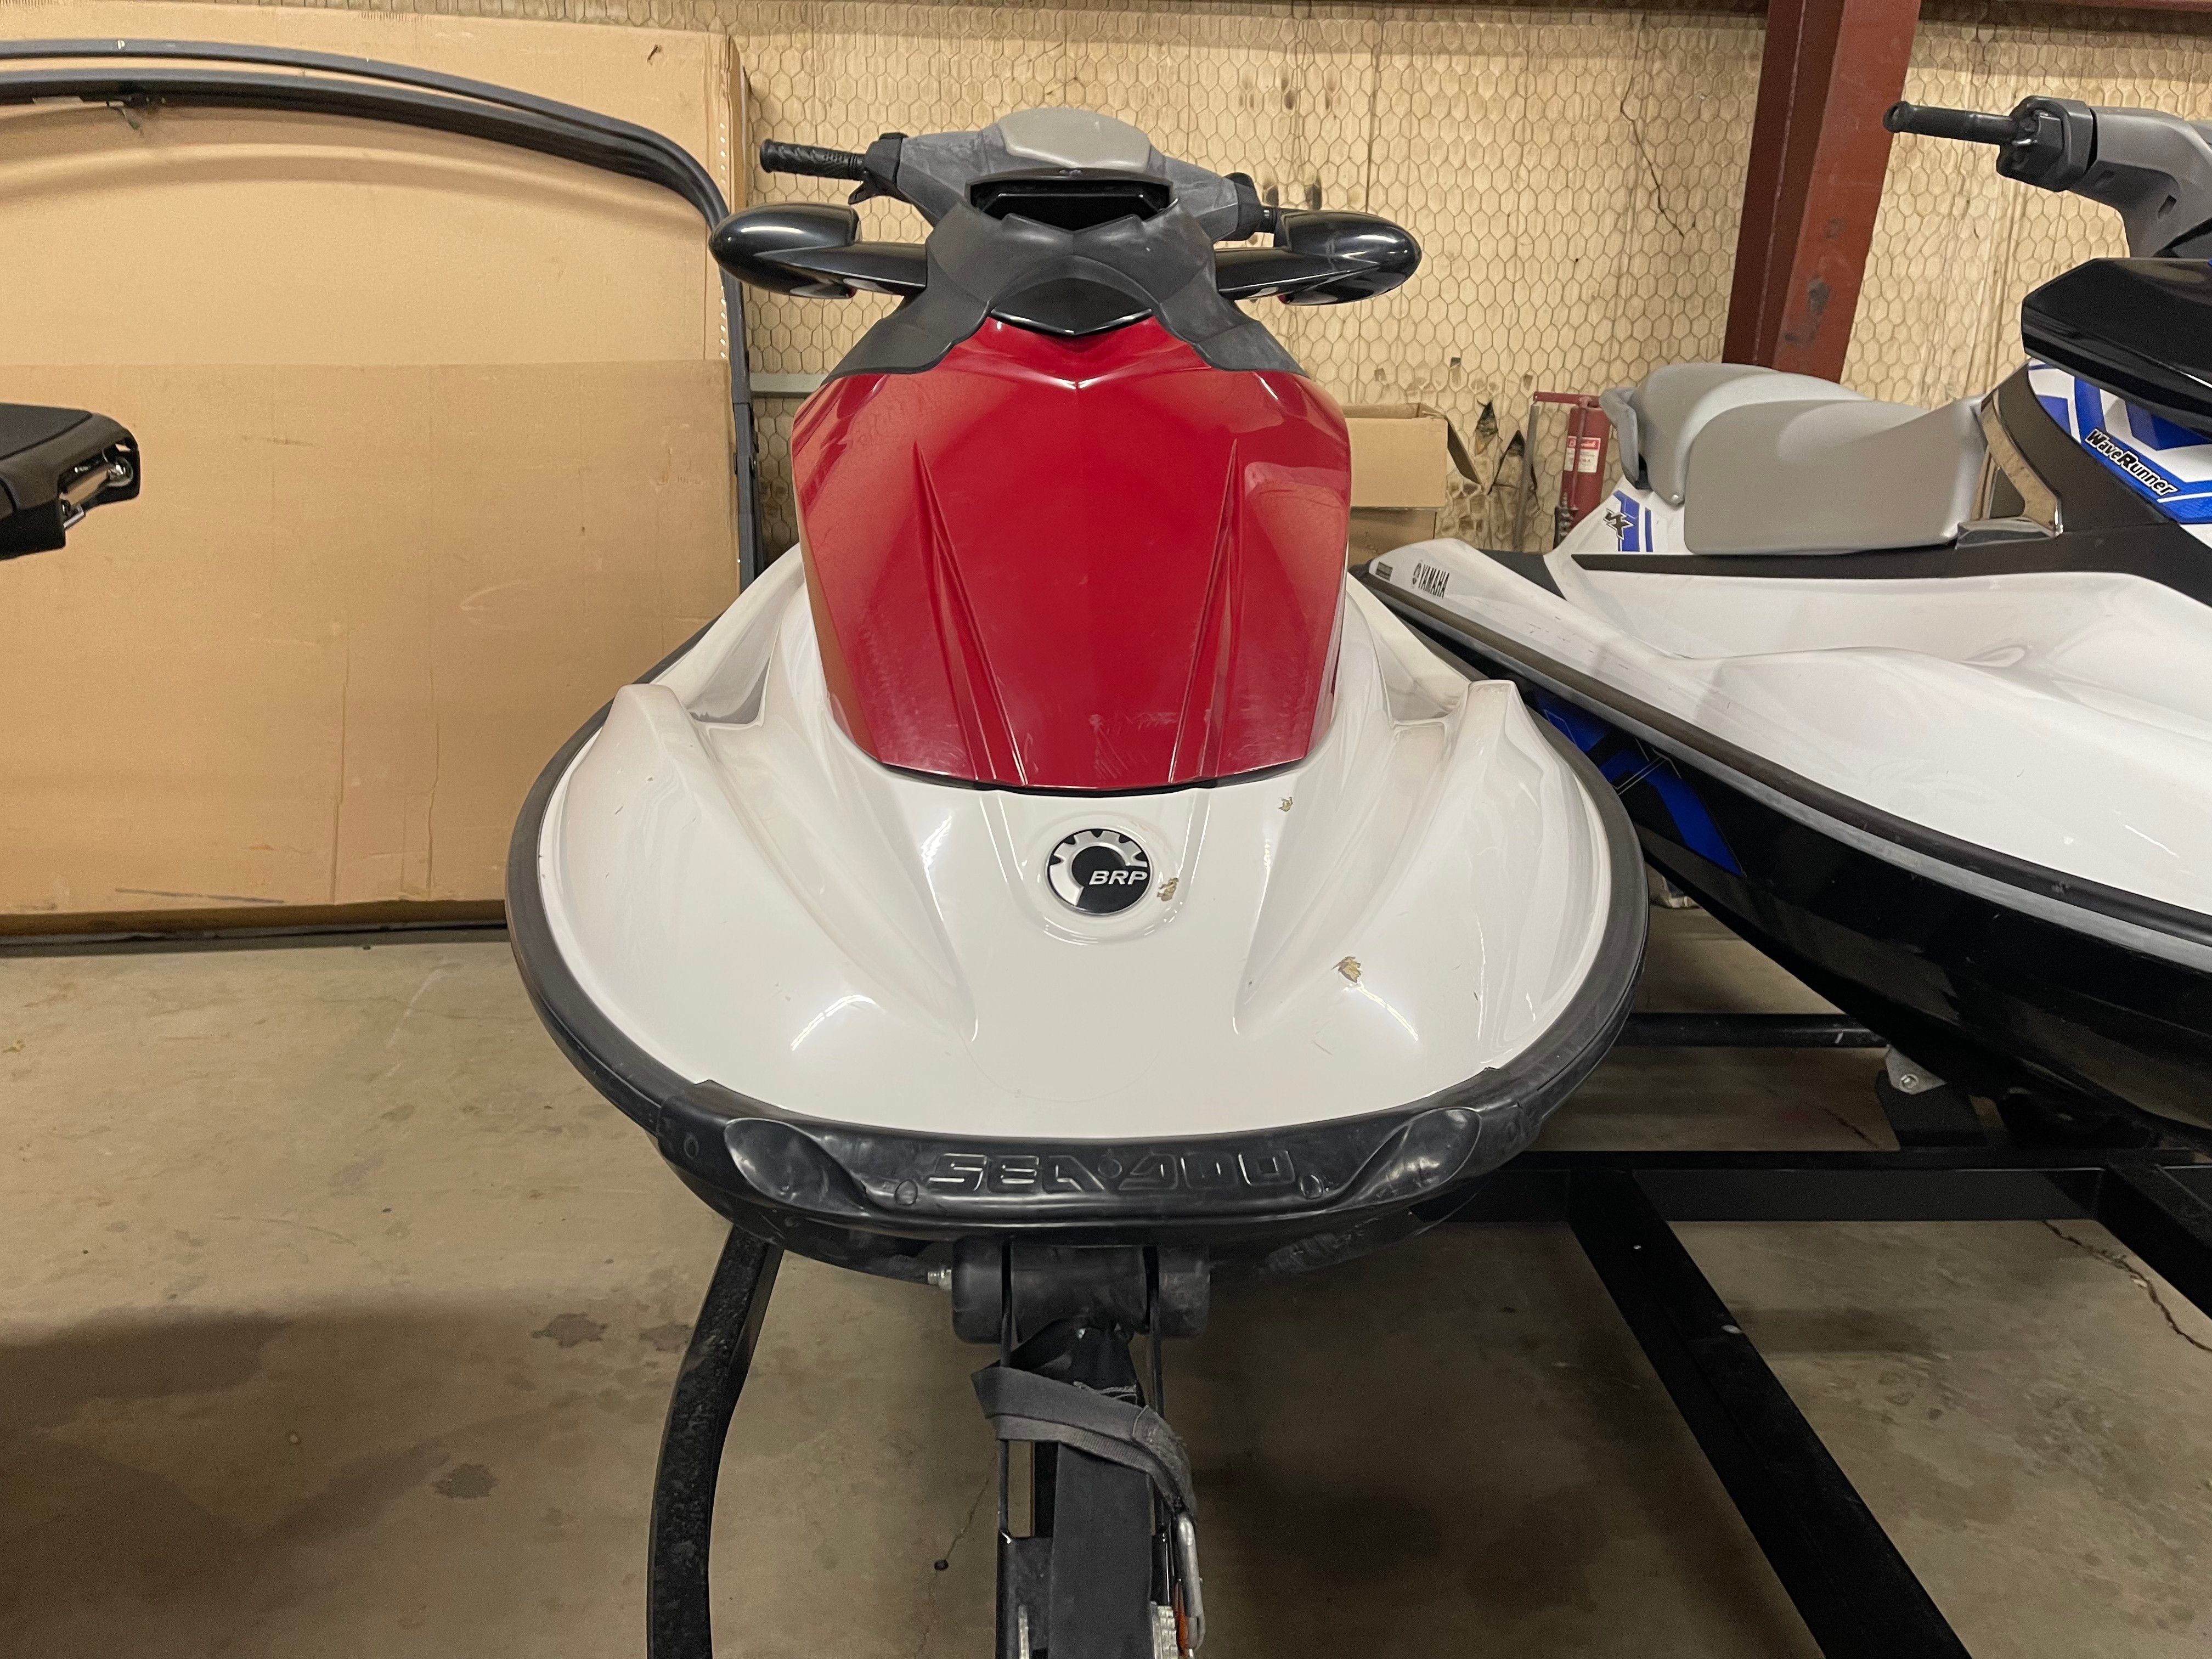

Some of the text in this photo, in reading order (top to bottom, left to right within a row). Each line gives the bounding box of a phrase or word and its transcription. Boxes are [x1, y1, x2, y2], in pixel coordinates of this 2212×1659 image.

[2085, 428, 2178, 495] WaveRunner
[1418, 563, 1450, 599] YAMAHA
[1089, 870, 1148, 885] BRP
